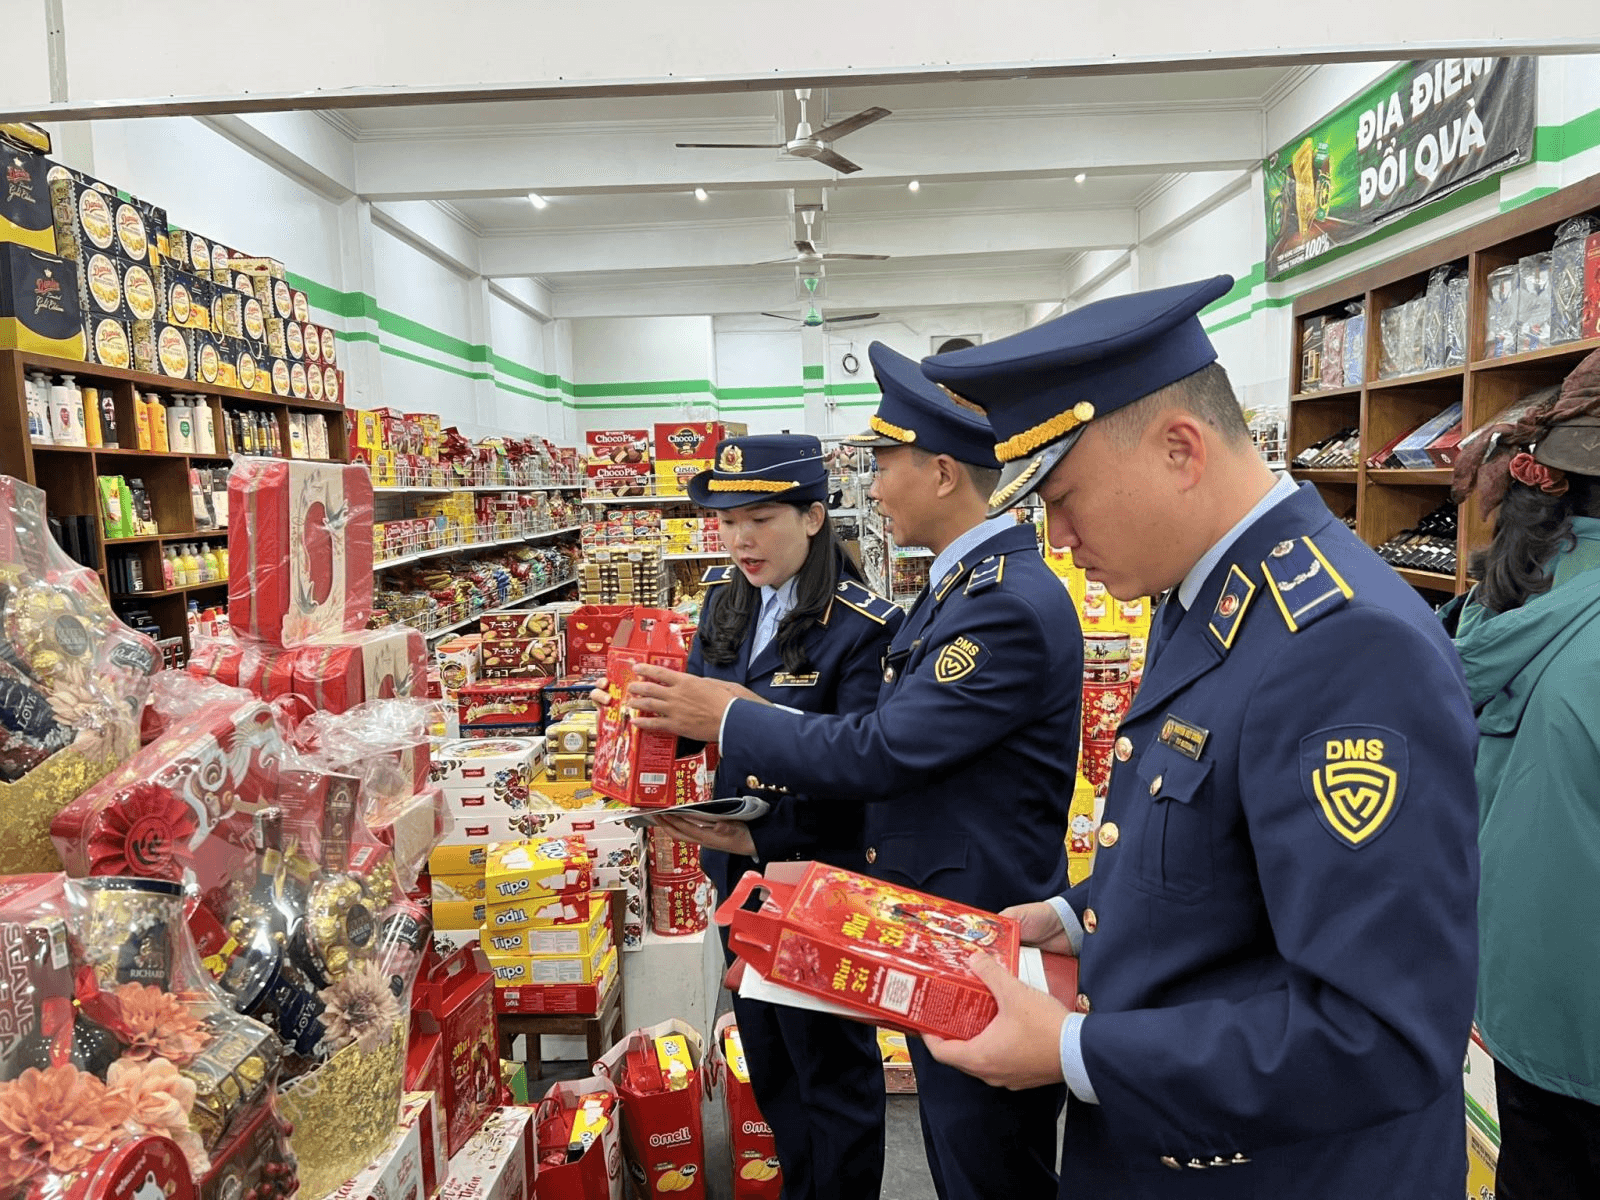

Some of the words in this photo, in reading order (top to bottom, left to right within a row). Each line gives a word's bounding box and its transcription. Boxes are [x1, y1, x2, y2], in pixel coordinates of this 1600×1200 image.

[1357, 92, 1404, 151] ĐỊA
[1359, 138, 1407, 208] ĐỔI
[1413, 97, 1486, 182] QUÀ
[954, 636, 980, 656] DMS
[485, 669, 509, 678] チョコ
[17, 692, 38, 729] LOVE
[1325, 738, 1384, 761] DMS
[496, 878, 530, 896] Tipo
[495, 908, 529, 926] Tipo
[490, 935, 522, 950] Tipo
[493, 964, 525, 980] Tipo
[293, 1000, 316, 1038] LOVE
